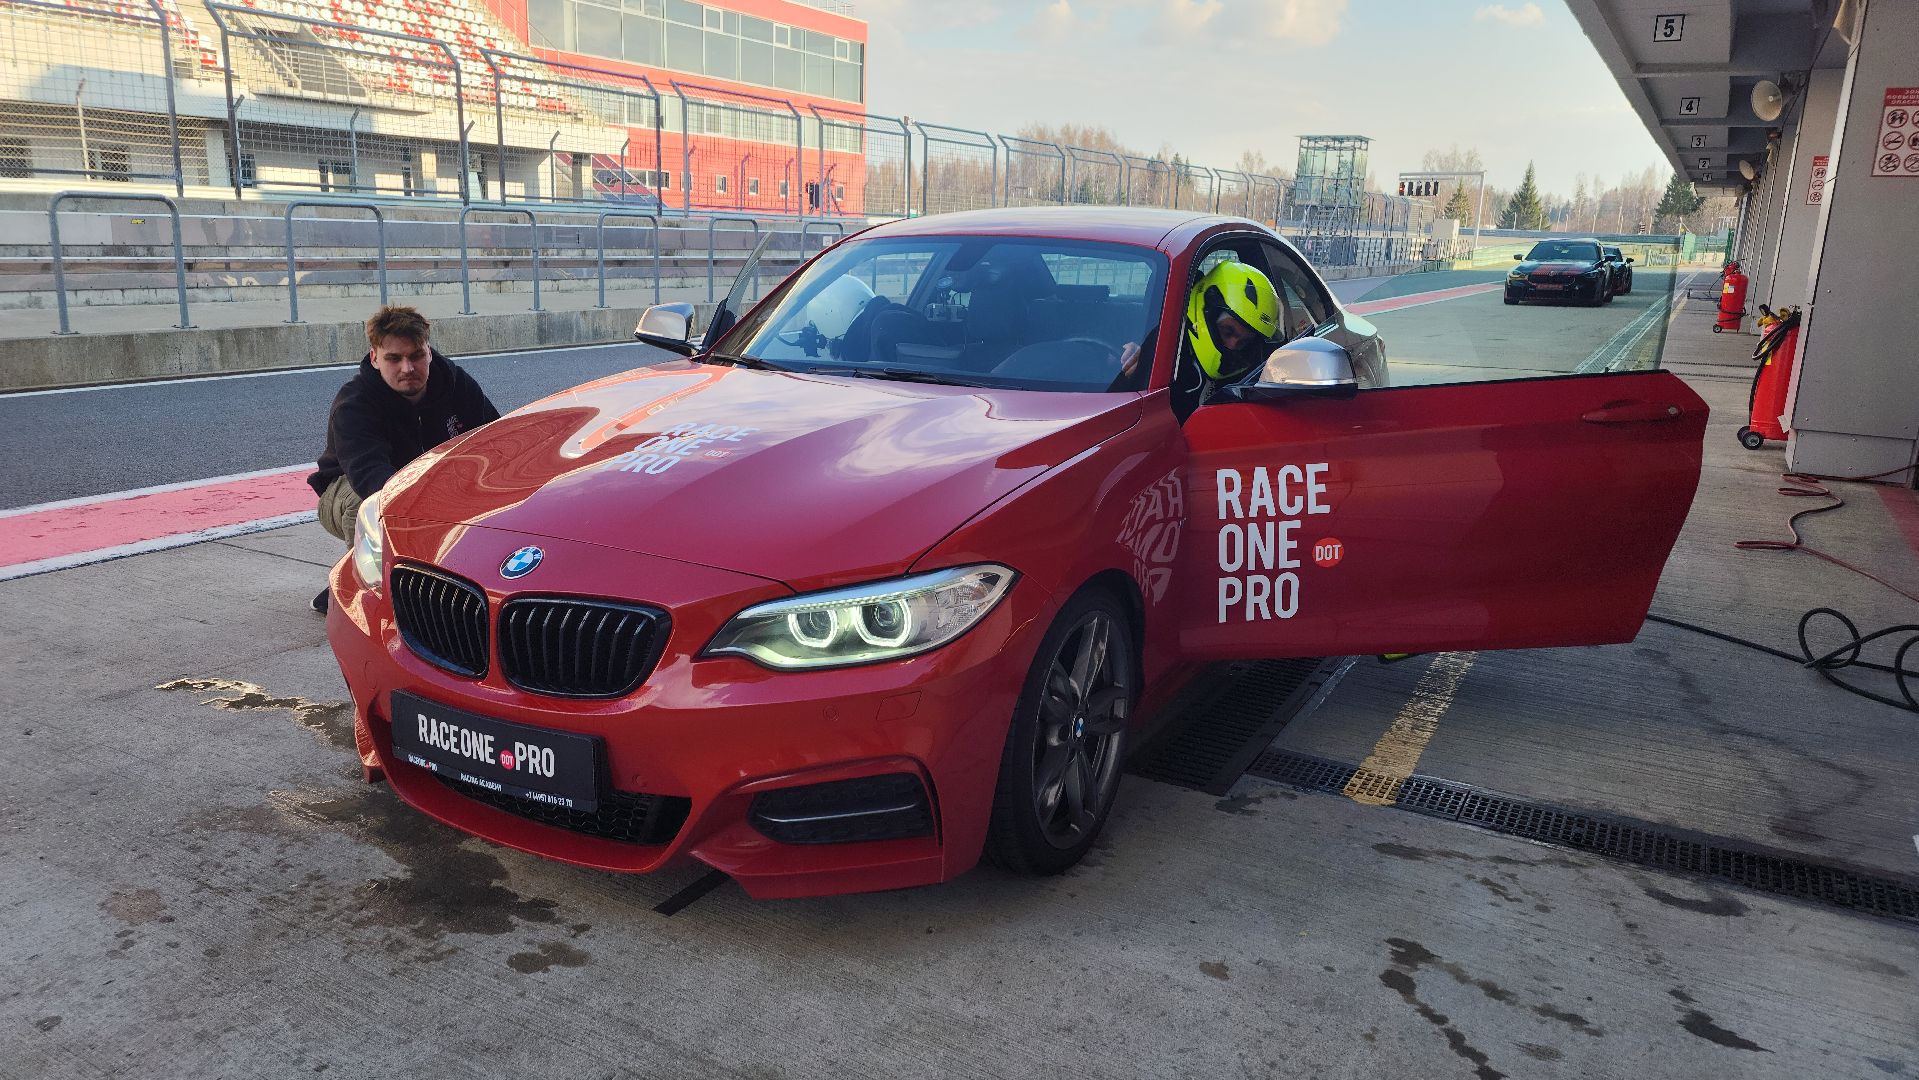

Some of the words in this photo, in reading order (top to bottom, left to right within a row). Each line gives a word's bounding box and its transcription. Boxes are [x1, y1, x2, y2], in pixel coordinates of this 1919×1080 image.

[1664, 19, 1675, 37] 5
[1685, 100, 1693, 112] 4
[1696, 137, 1702, 147] 3
[1701, 160, 1707, 168] 2
[660, 422, 760, 442] RACE
[634, 435, 715, 456] ONE
[704, 450, 731, 458] DOT
[599, 451, 681, 475] PRO
[1216, 463, 1331, 520] RACE
[1218, 519, 1302, 573] ONE
[1315, 544, 1342, 562] DOT
[1218, 571, 1300, 624] PRO
[501, 753, 514, 767] DOT
[514, 741, 555, 778] PRO
